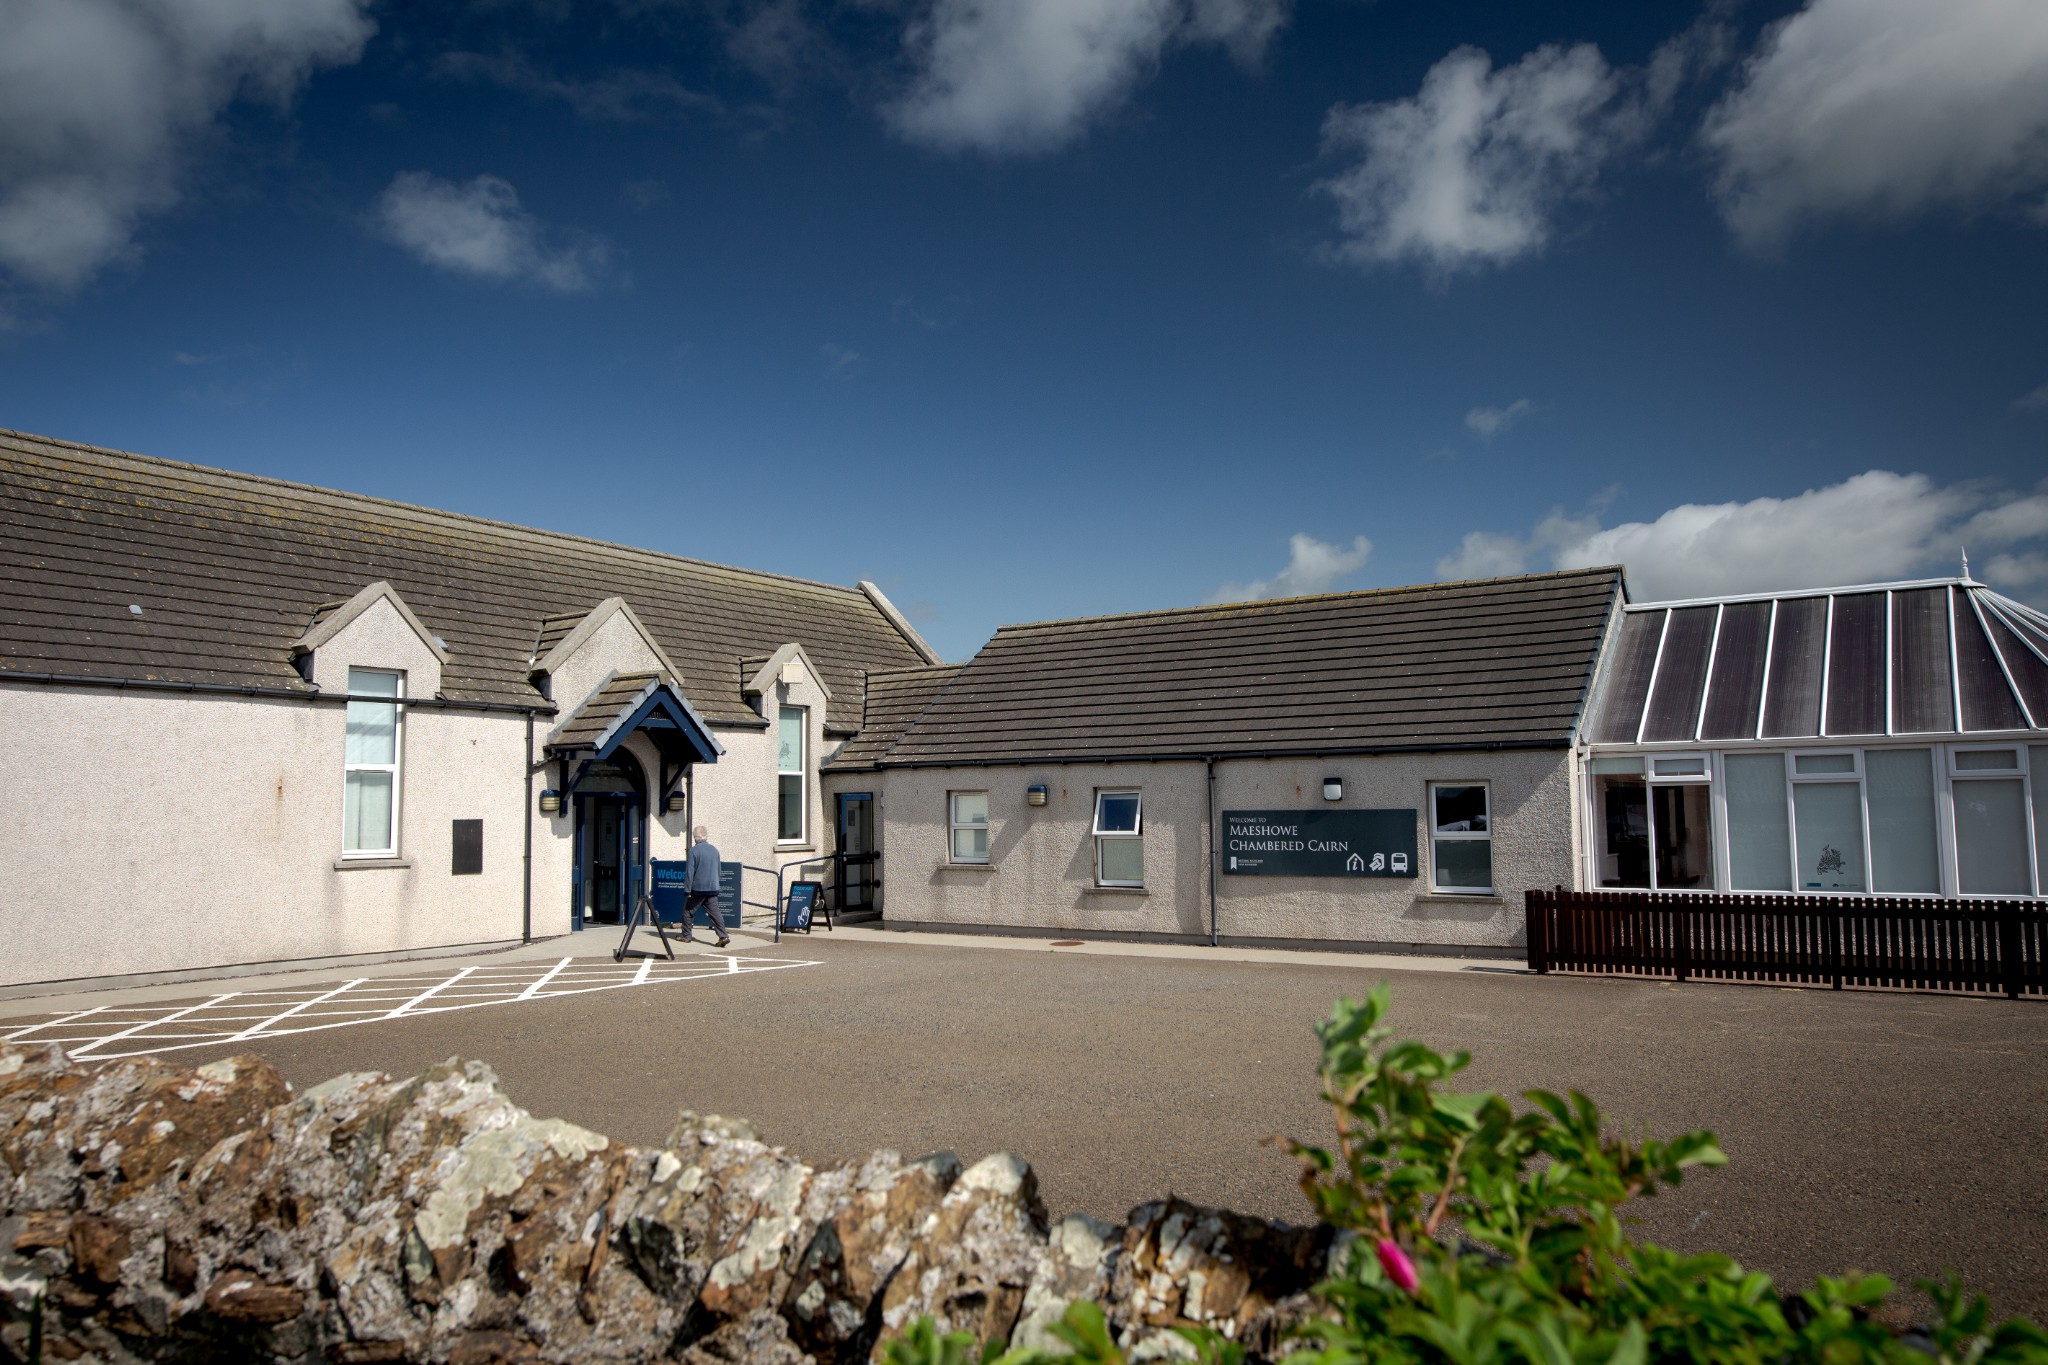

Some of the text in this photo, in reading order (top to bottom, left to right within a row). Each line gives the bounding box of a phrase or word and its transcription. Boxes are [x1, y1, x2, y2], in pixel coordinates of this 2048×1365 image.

[1230, 825, 1298, 835] MAESHOWE
[1230, 840, 1348, 851] CHAMBERED CAIRN
[657, 869, 686, 879] Welco
